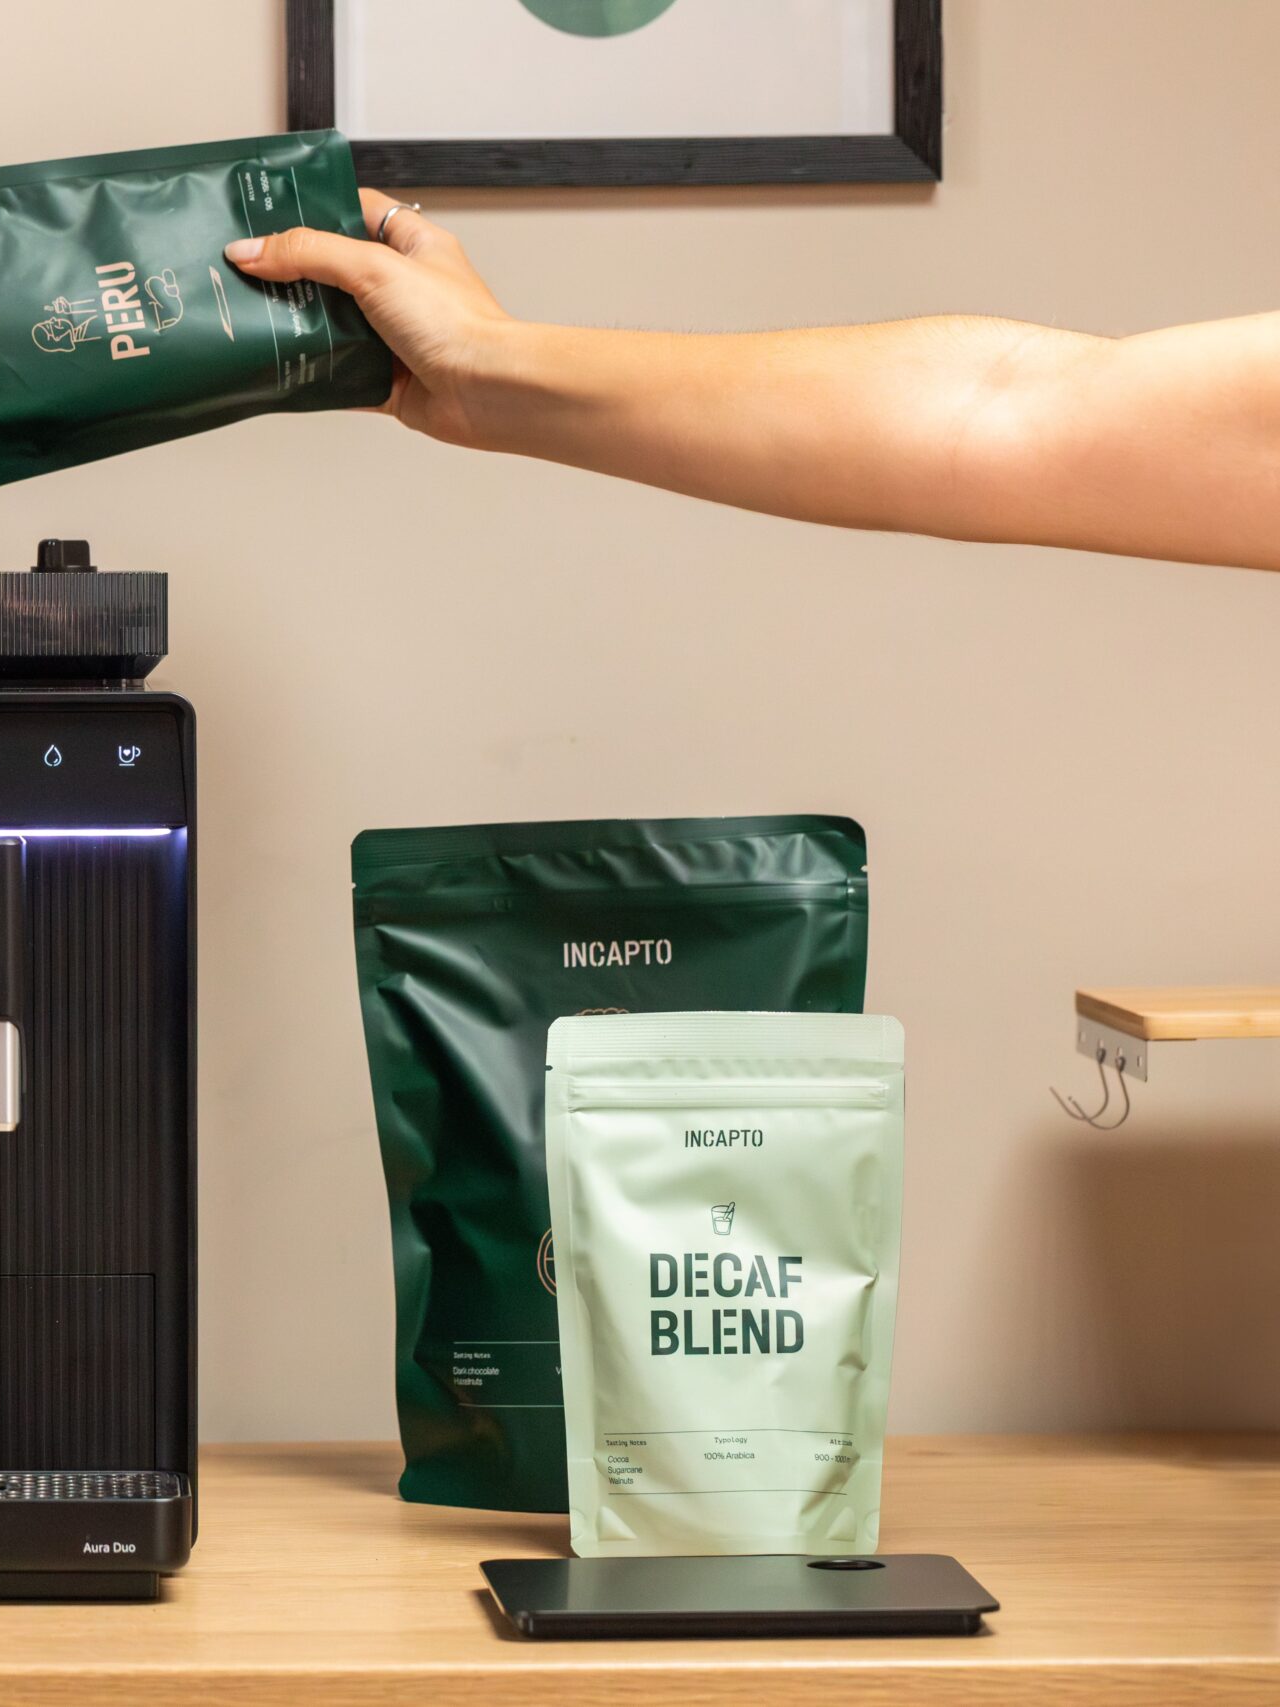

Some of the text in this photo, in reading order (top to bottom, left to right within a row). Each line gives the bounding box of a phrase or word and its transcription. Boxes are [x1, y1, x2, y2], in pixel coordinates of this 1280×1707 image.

[95, 261, 151, 361] PERU
[563, 939, 673, 968] INCAPTO
[684, 1129, 764, 1148] INCAPTO
[649, 1252, 803, 1299] DECAF
[650, 1308, 805, 1356] BLEND
[606, 1439, 628, 1447] Tasting
[714, 1436, 748, 1444] Typology
[830, 1439, 853, 1447] Altde
[607, 1455, 629, 1464] Cocoa
[704, 1451, 755, 1460] 100% Arabica
[815, 1453, 830, 1462] 900
[607, 1466, 643, 1475] Sugarcane
[608, 1477, 634, 1485] Walnuts
[83, 1542, 136, 1553] Aura Duo
